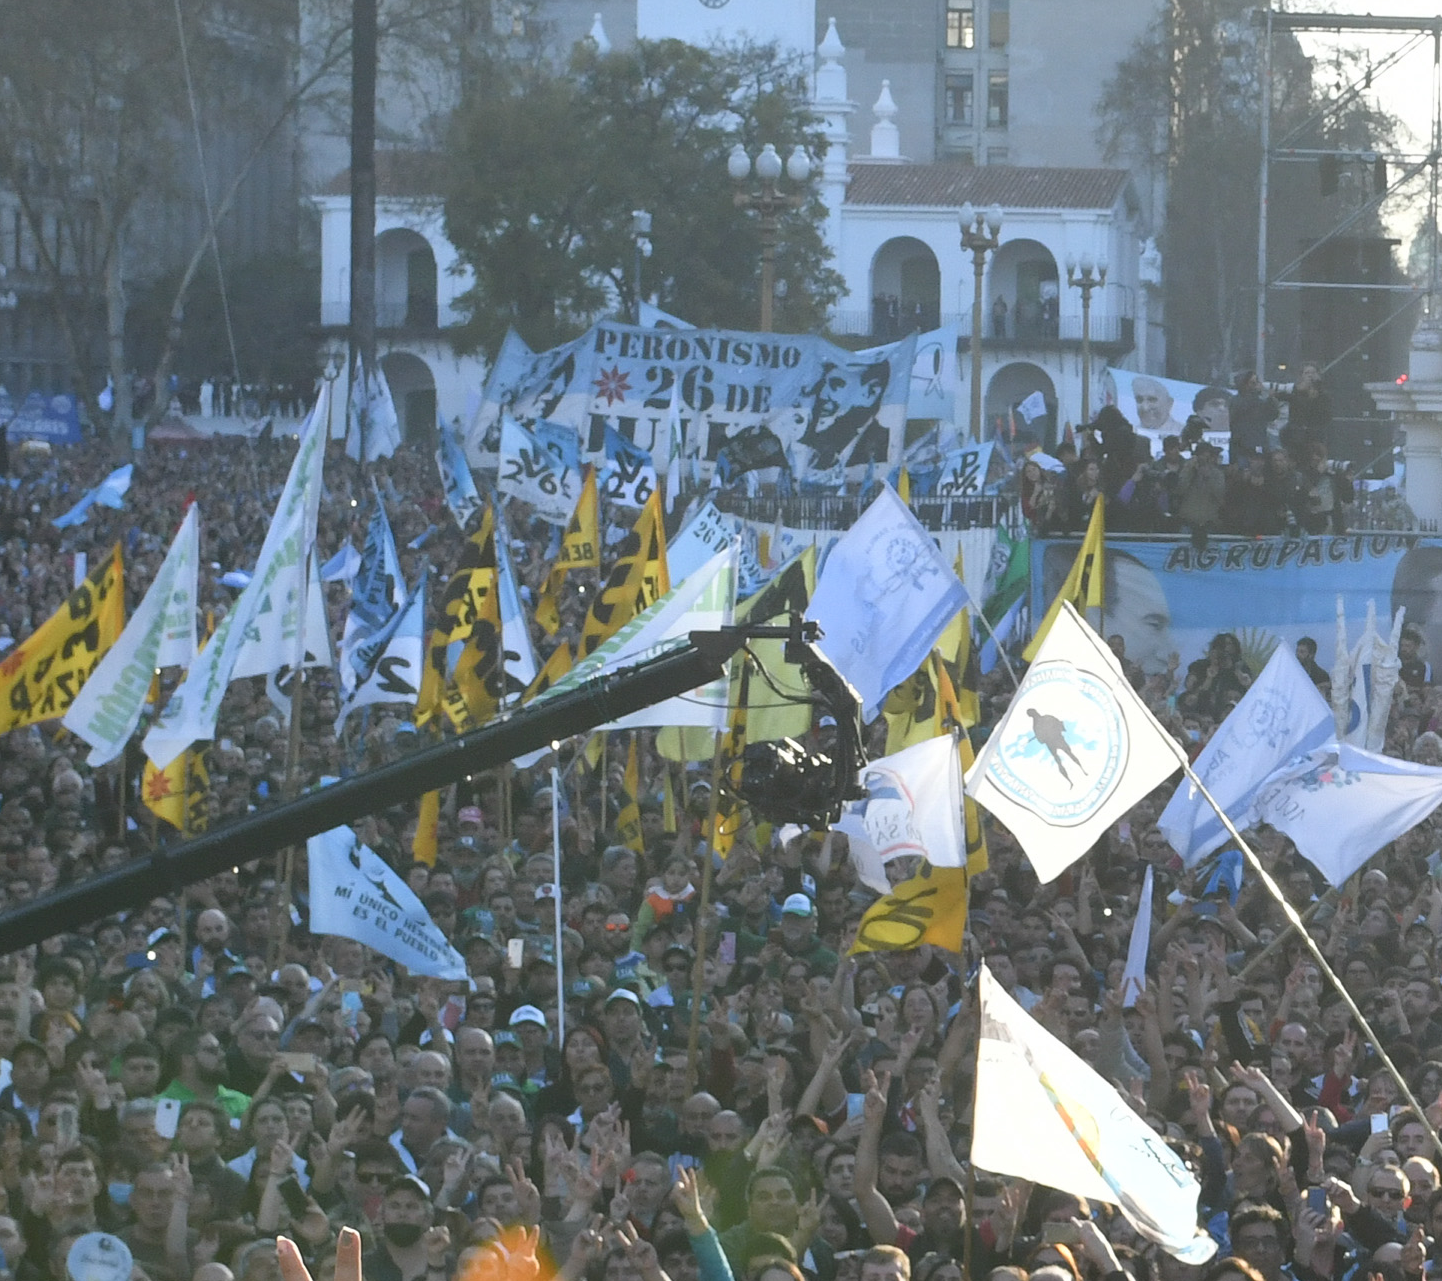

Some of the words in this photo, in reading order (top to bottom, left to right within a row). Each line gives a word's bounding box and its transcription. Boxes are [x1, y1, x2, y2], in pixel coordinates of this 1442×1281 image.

[594, 329, 802, 370] PERONISMO
[643, 364, 715, 413] 26
[725, 383, 772, 414] DE
[394, 928, 440, 962] PUEBLO
